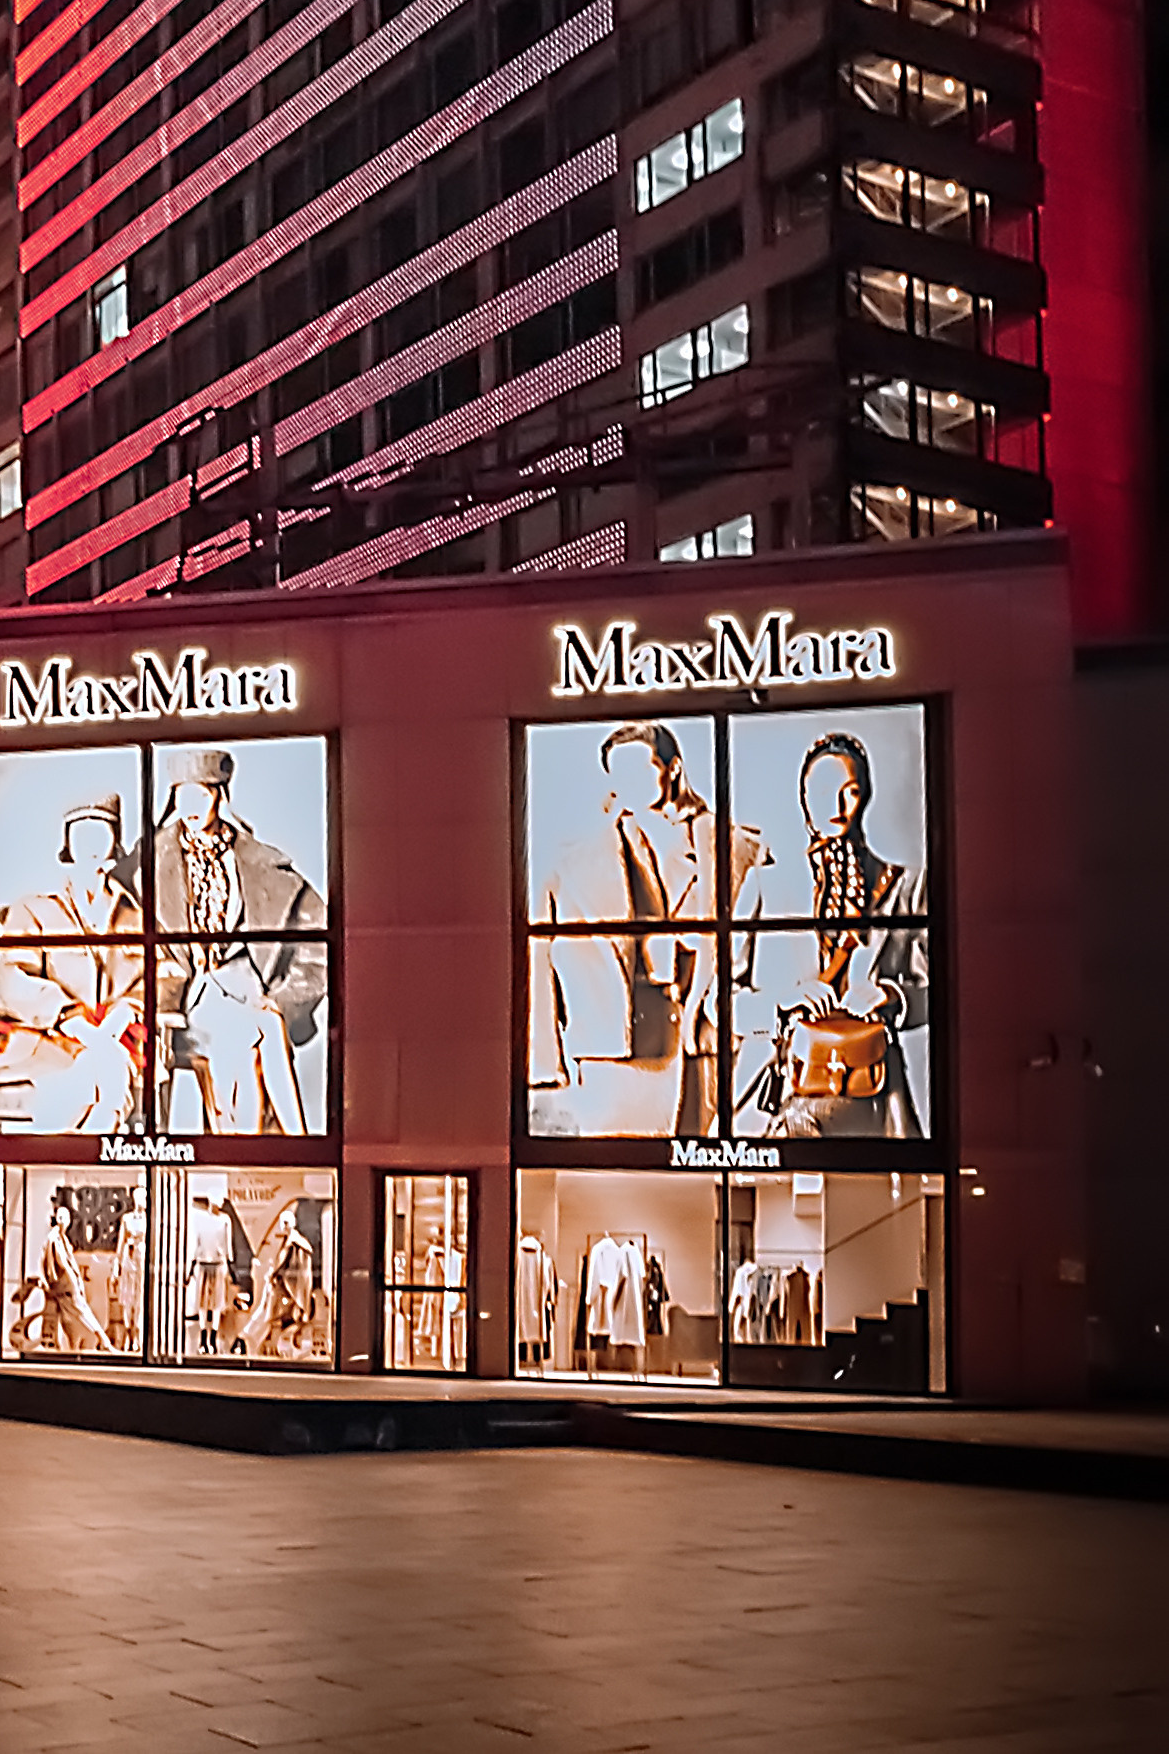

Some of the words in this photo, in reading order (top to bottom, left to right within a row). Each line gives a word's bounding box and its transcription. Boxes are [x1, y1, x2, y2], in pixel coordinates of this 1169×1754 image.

[552, 610, 897, 696] MaxMara
[99, 1136, 195, 1162] MaxMara
[670, 1139, 781, 1167] MaxMara
